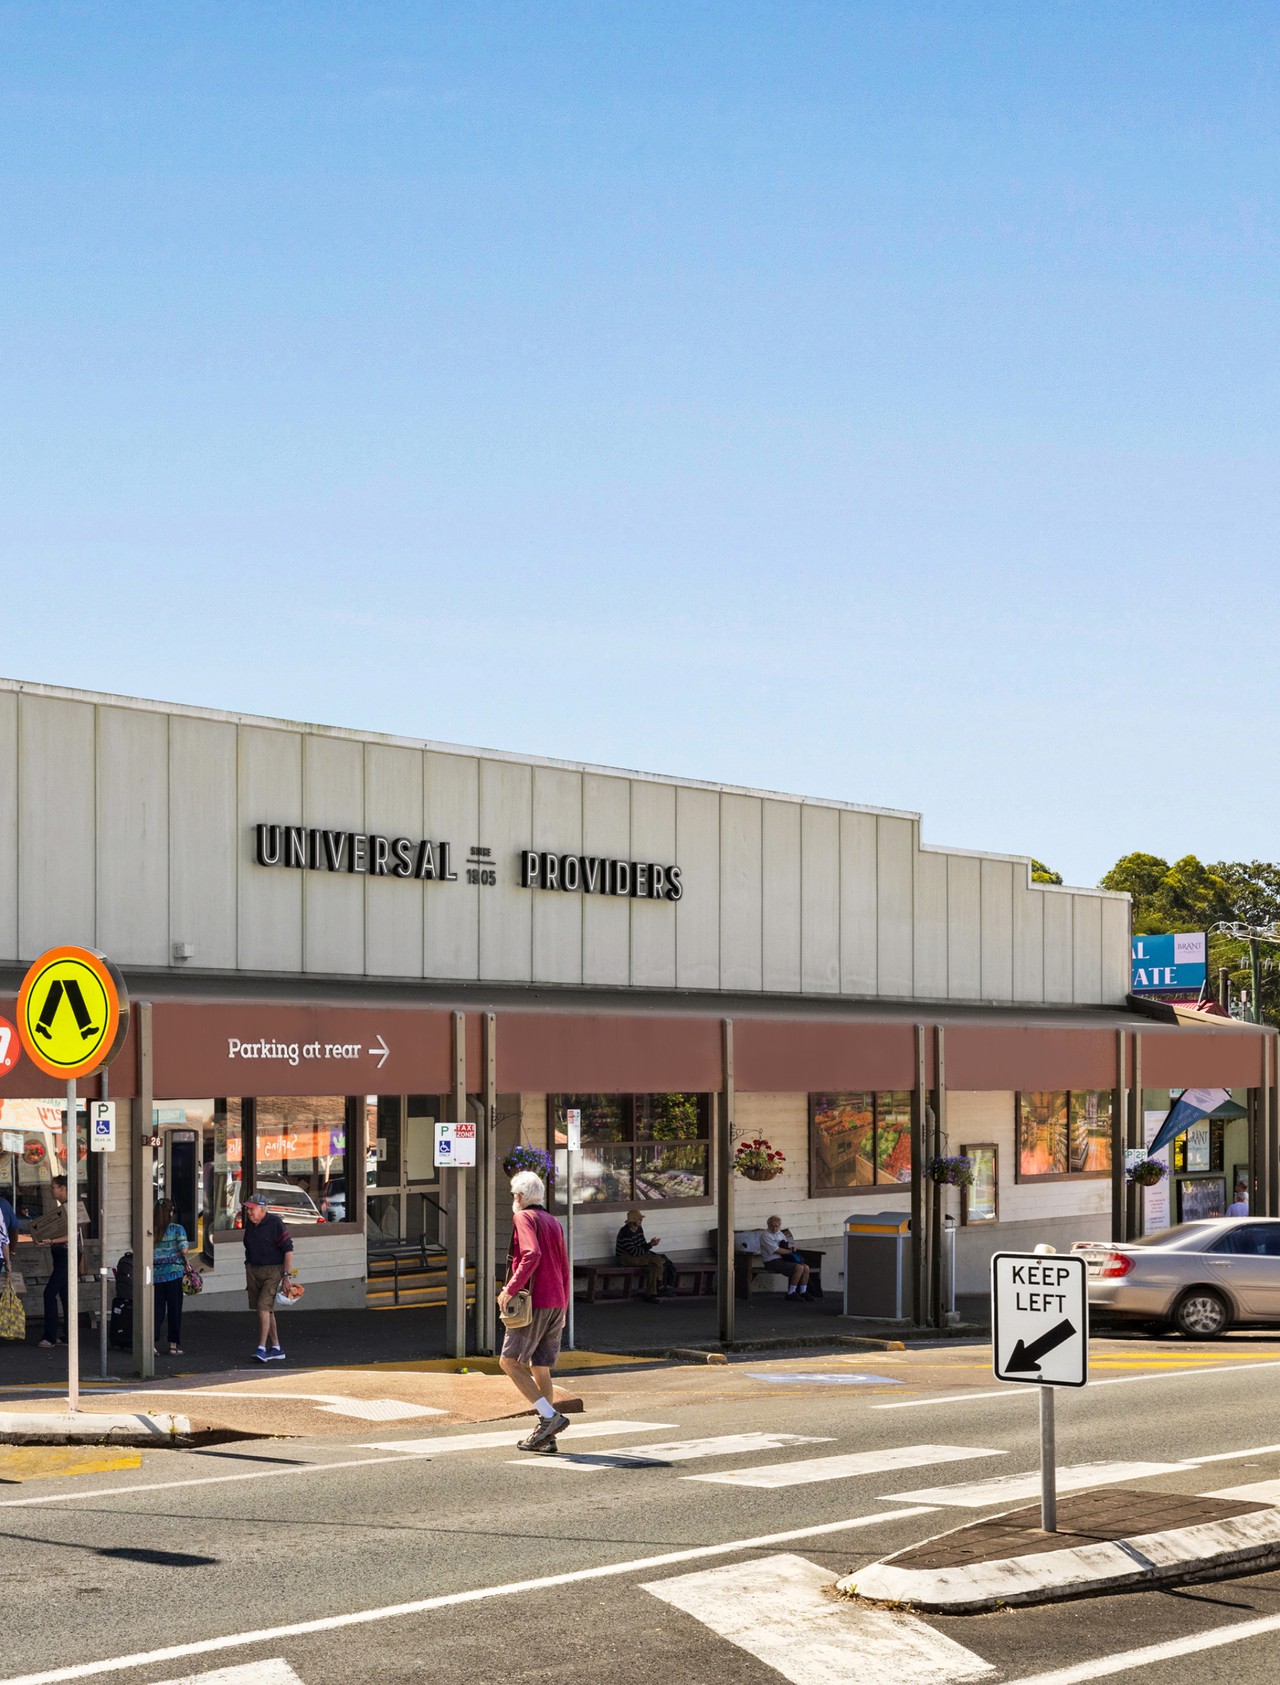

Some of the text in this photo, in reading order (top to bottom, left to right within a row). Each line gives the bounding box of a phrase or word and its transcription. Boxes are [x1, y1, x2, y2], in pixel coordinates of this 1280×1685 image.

[470, 846, 491, 857] SINCE
[254, 823, 683, 901] UNIVERSAL PROVIDERS
[466, 869, 496, 886] 1905
[1177, 942, 1203, 951] BRANT
[1132, 966, 1177, 986] ATE
[228, 1038, 361, 1066] Parking at rear
[98, 1104, 109, 1118] P
[441, 1126, 449, 1136] P
[150, 1136, 161, 1146] 26
[1012, 1265, 1070, 1287] KEEP
[1016, 1292, 1066, 1313] LEFT
